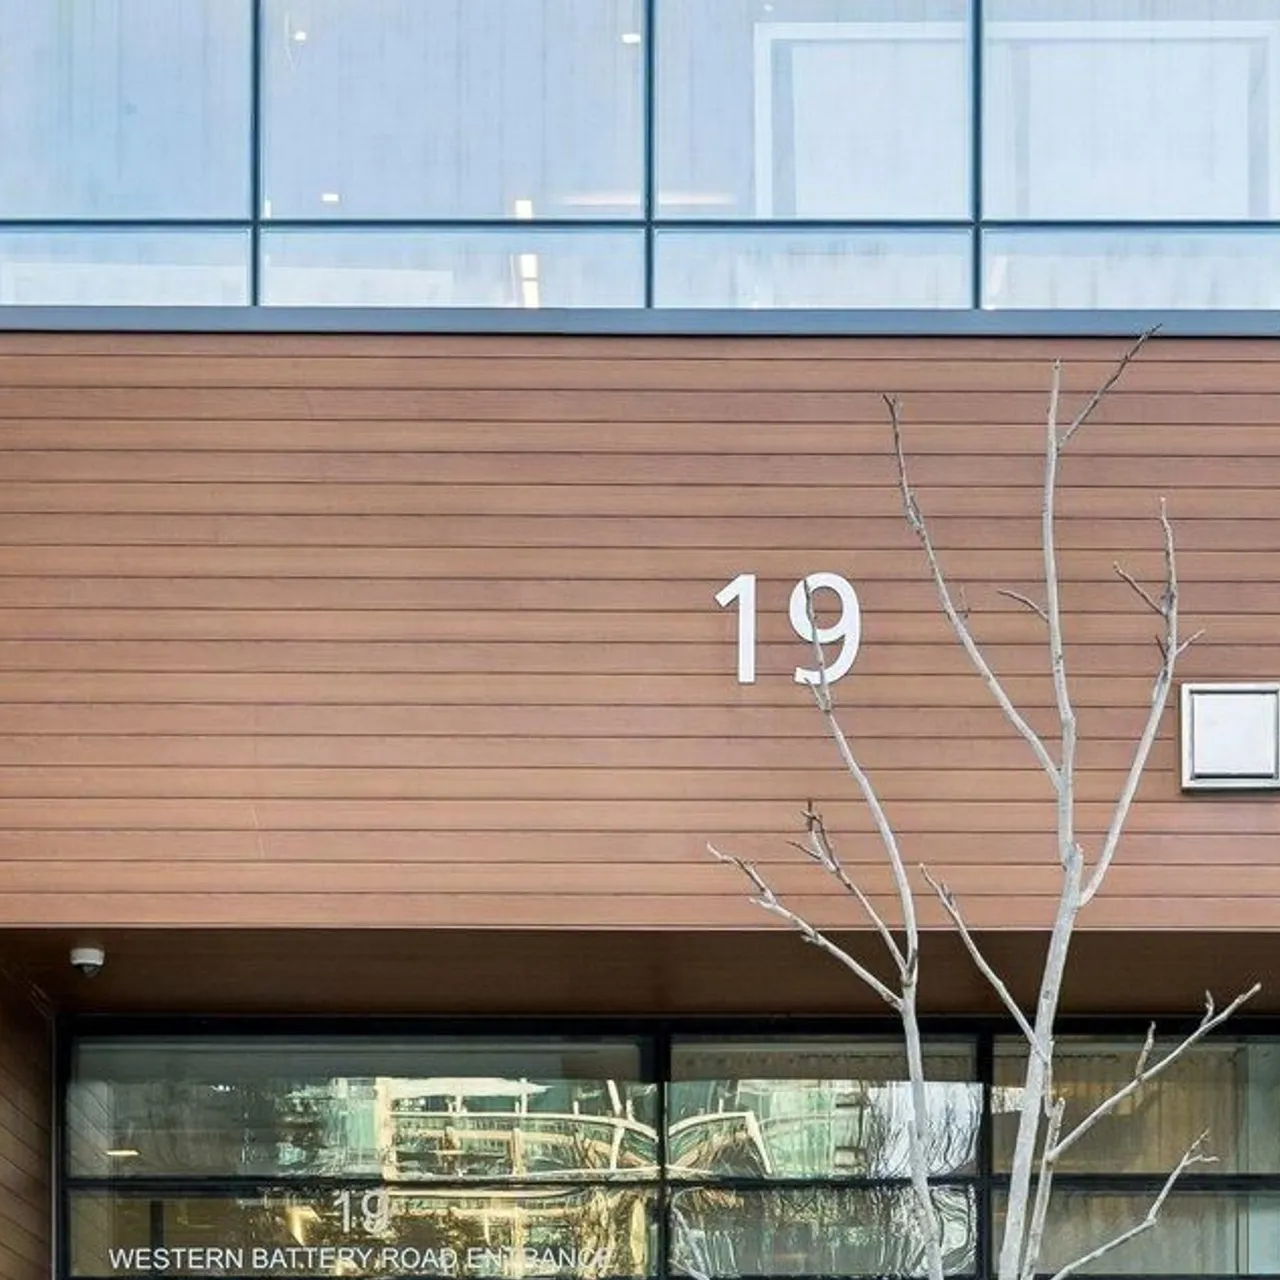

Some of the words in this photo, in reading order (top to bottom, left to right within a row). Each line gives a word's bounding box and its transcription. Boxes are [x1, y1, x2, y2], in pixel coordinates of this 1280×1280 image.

[715, 571, 861, 684] 19
[333, 1188, 390, 1234] 19
[109, 1247, 243, 1270] WESTERN
[252, 1247, 373, 1270] BATTERY
[382, 1247, 458, 1270] ROAD
[468, 1246, 614, 1270] ENTRANCE
